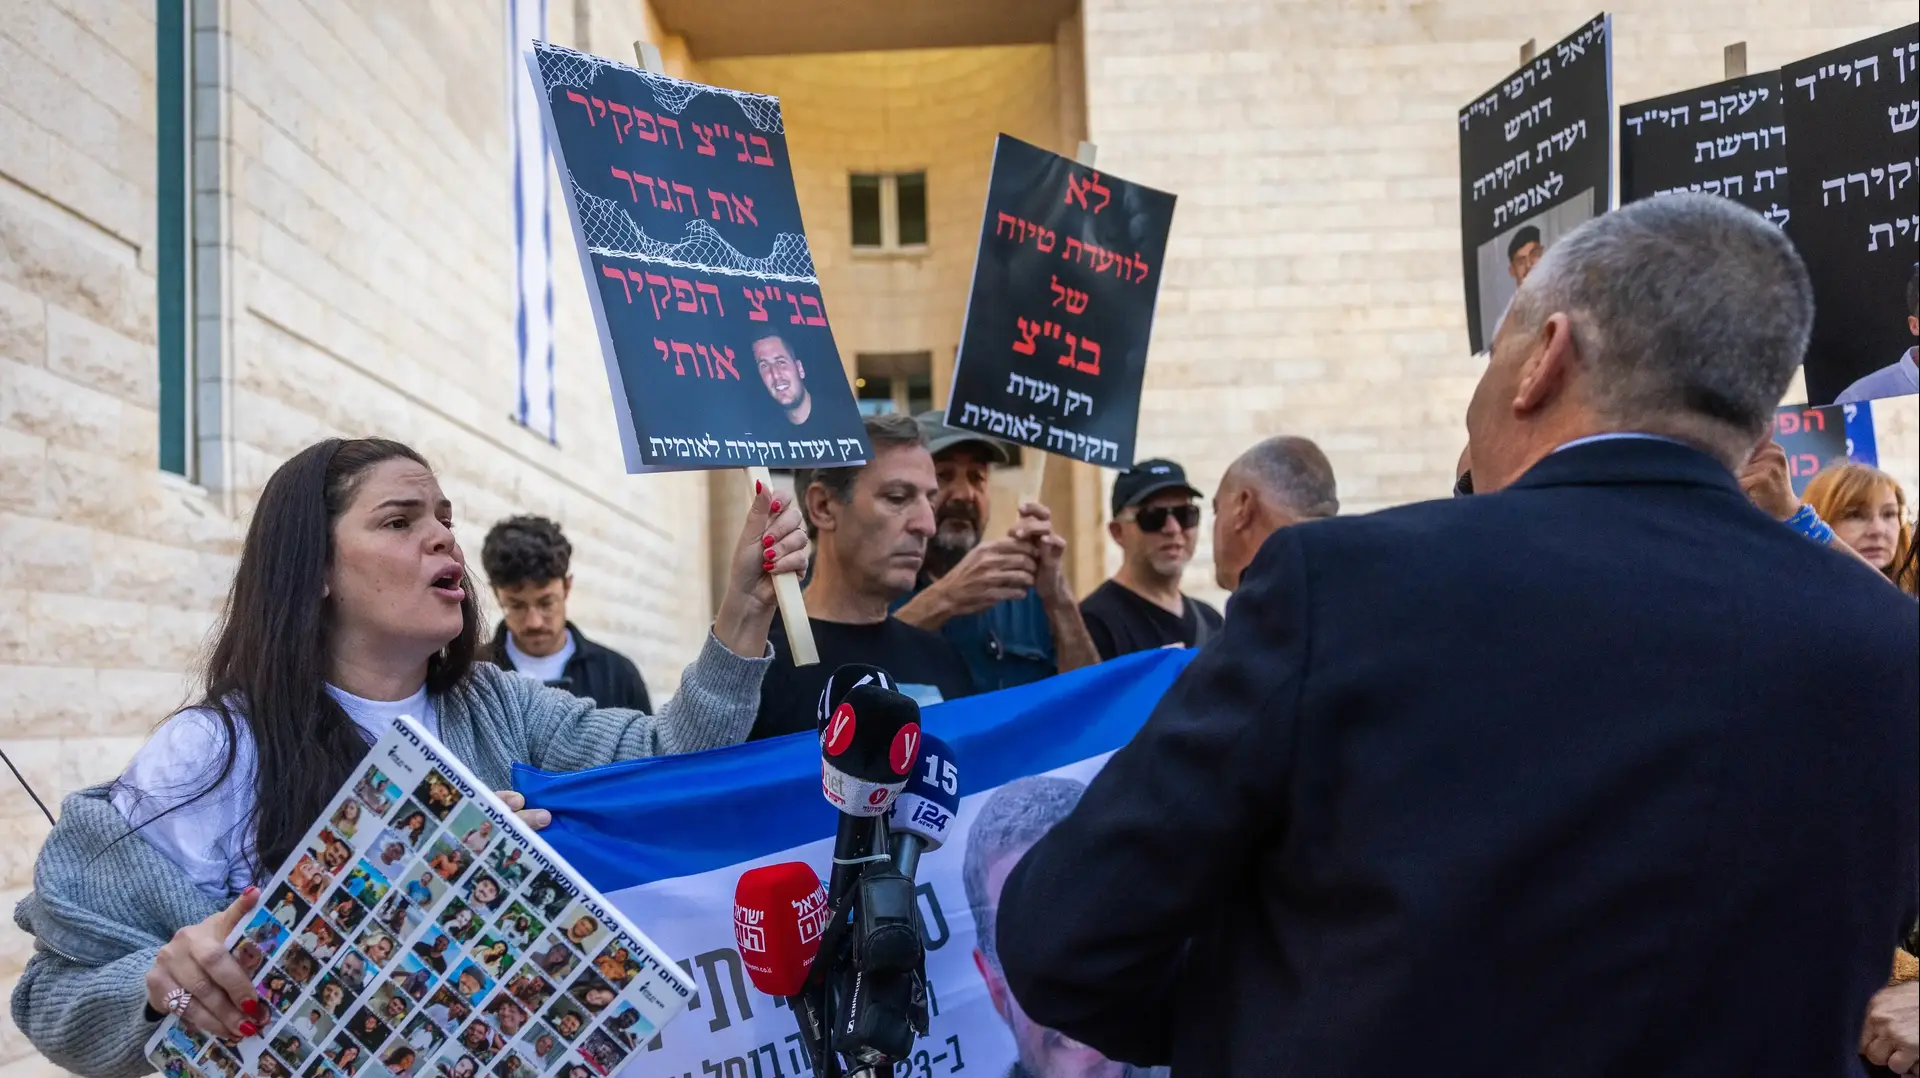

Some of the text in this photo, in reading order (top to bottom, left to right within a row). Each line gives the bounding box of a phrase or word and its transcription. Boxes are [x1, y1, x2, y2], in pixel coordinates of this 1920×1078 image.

[1557, 19, 1605, 67] ליאל
[566, 89, 775, 167] בג"צ הפקיר
[1504, 97, 1553, 142] דורש
[1699, 87, 1769, 124] יעקב
[1473, 119, 1587, 201] ועדת חקירה
[1822, 157, 1919, 207] קירה
[611, 165, 759, 227] את הגדר
[1064, 170, 1111, 214] לא
[1493, 170, 1564, 228] לאומית
[996, 211, 1149, 285] לוועדת טיוח
[602, 263, 828, 327] בג"צ הפקיר
[1050, 275, 1089, 315] של
[653, 337, 741, 382] אותי
[1012, 316, 1101, 377] בג"צ
[1006, 371, 1094, 418] רק ועדת
[650, 432, 864, 466] רק ועדת חקירה לאומית
[960, 401, 1119, 464] חקירה לאומית
[823, 771, 845, 797] net
[922, 754, 958, 796] 15
[484, 806, 529, 849] השכולות
[912, 800, 950, 832] i24
[918, 819, 934, 830] NEWS
[528, 847, 580, 898] המשפחות
[580, 893, 619, 933] 7.10.23
[617, 930, 645, 956] וצדק
[641, 954, 659, 972] דין
[658, 969, 689, 998] פורום
[851, 971, 862, 1018] SENNHEISER
